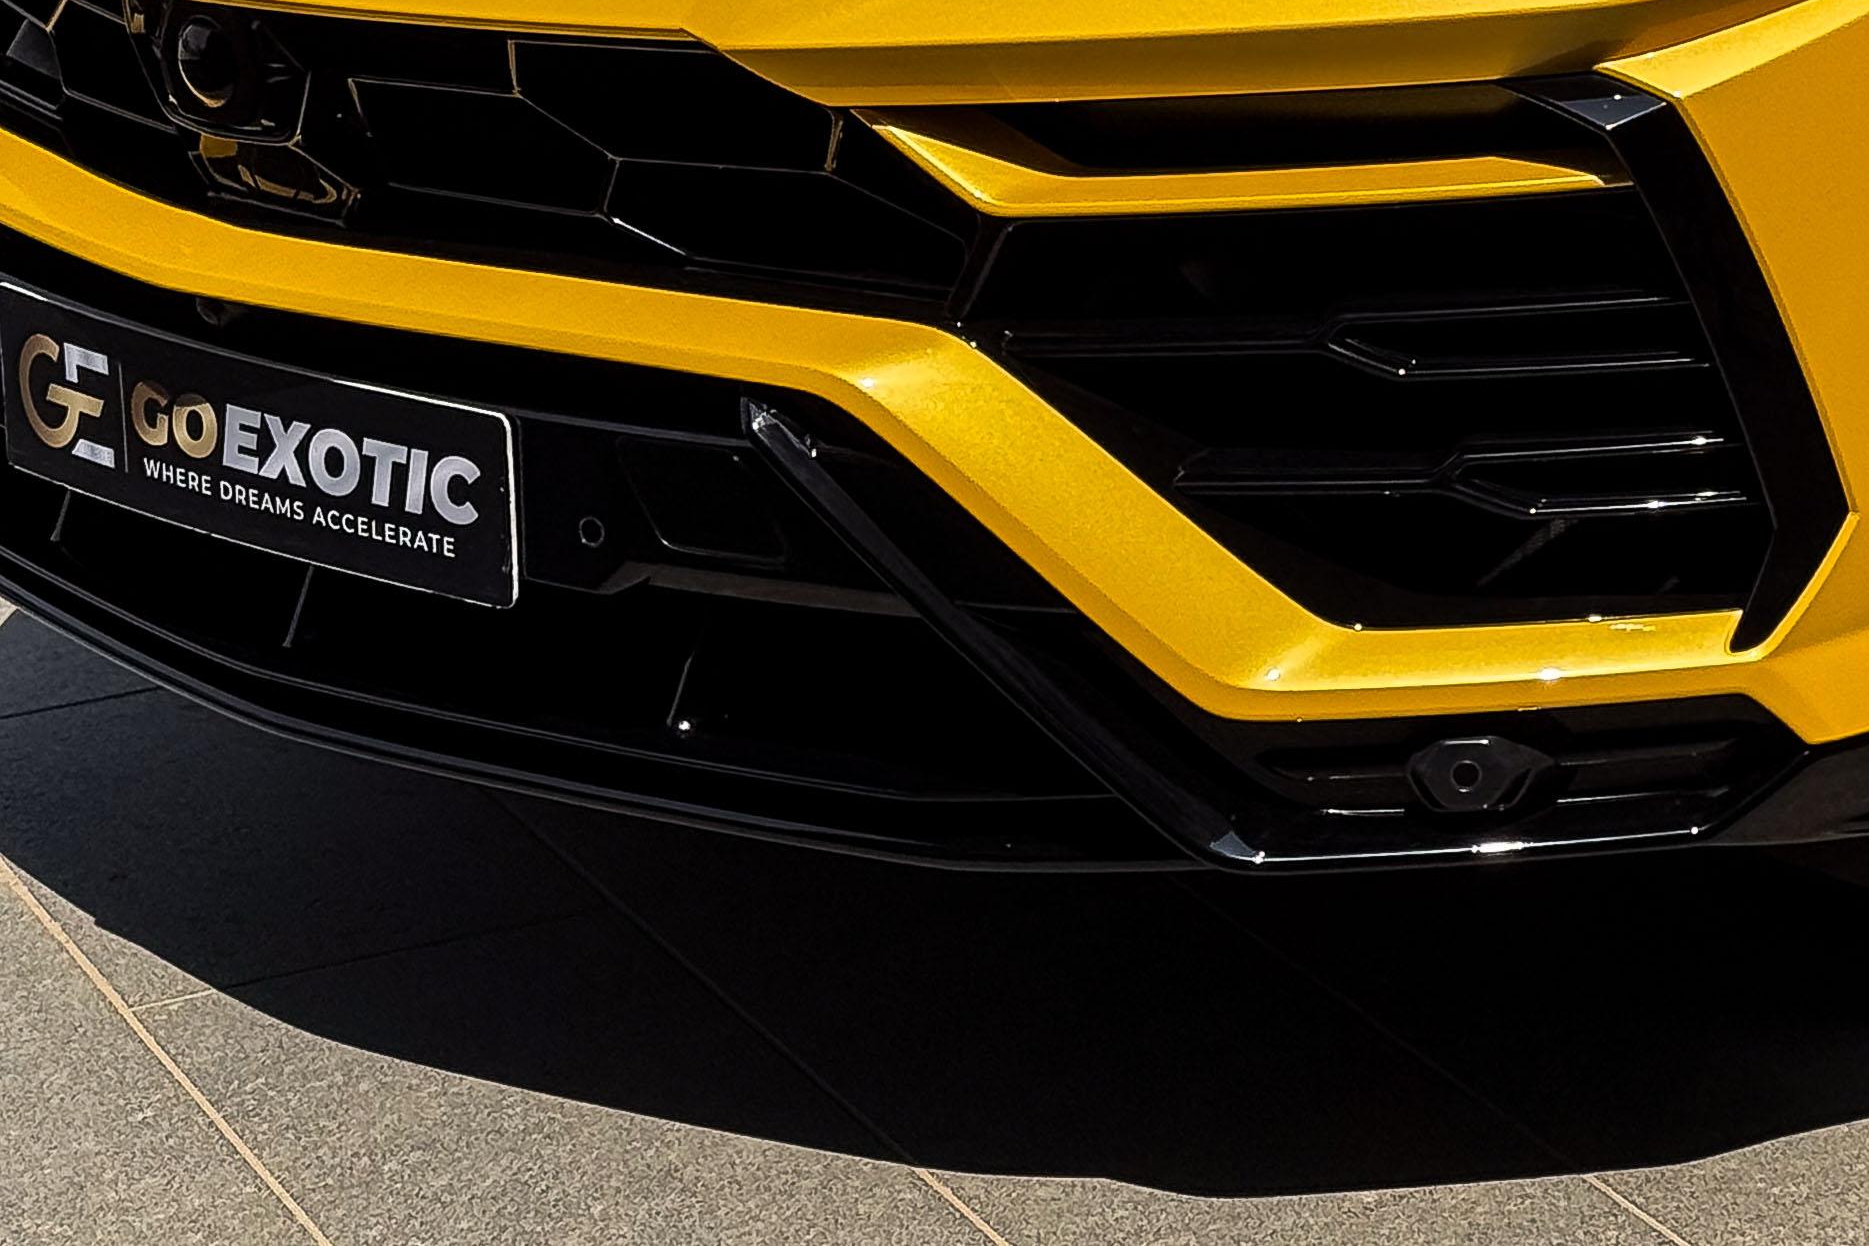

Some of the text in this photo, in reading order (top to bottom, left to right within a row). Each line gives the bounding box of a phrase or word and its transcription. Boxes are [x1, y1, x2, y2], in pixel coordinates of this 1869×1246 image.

[143, 457, 457, 559] WHERE DREAMS ACCELERATE
